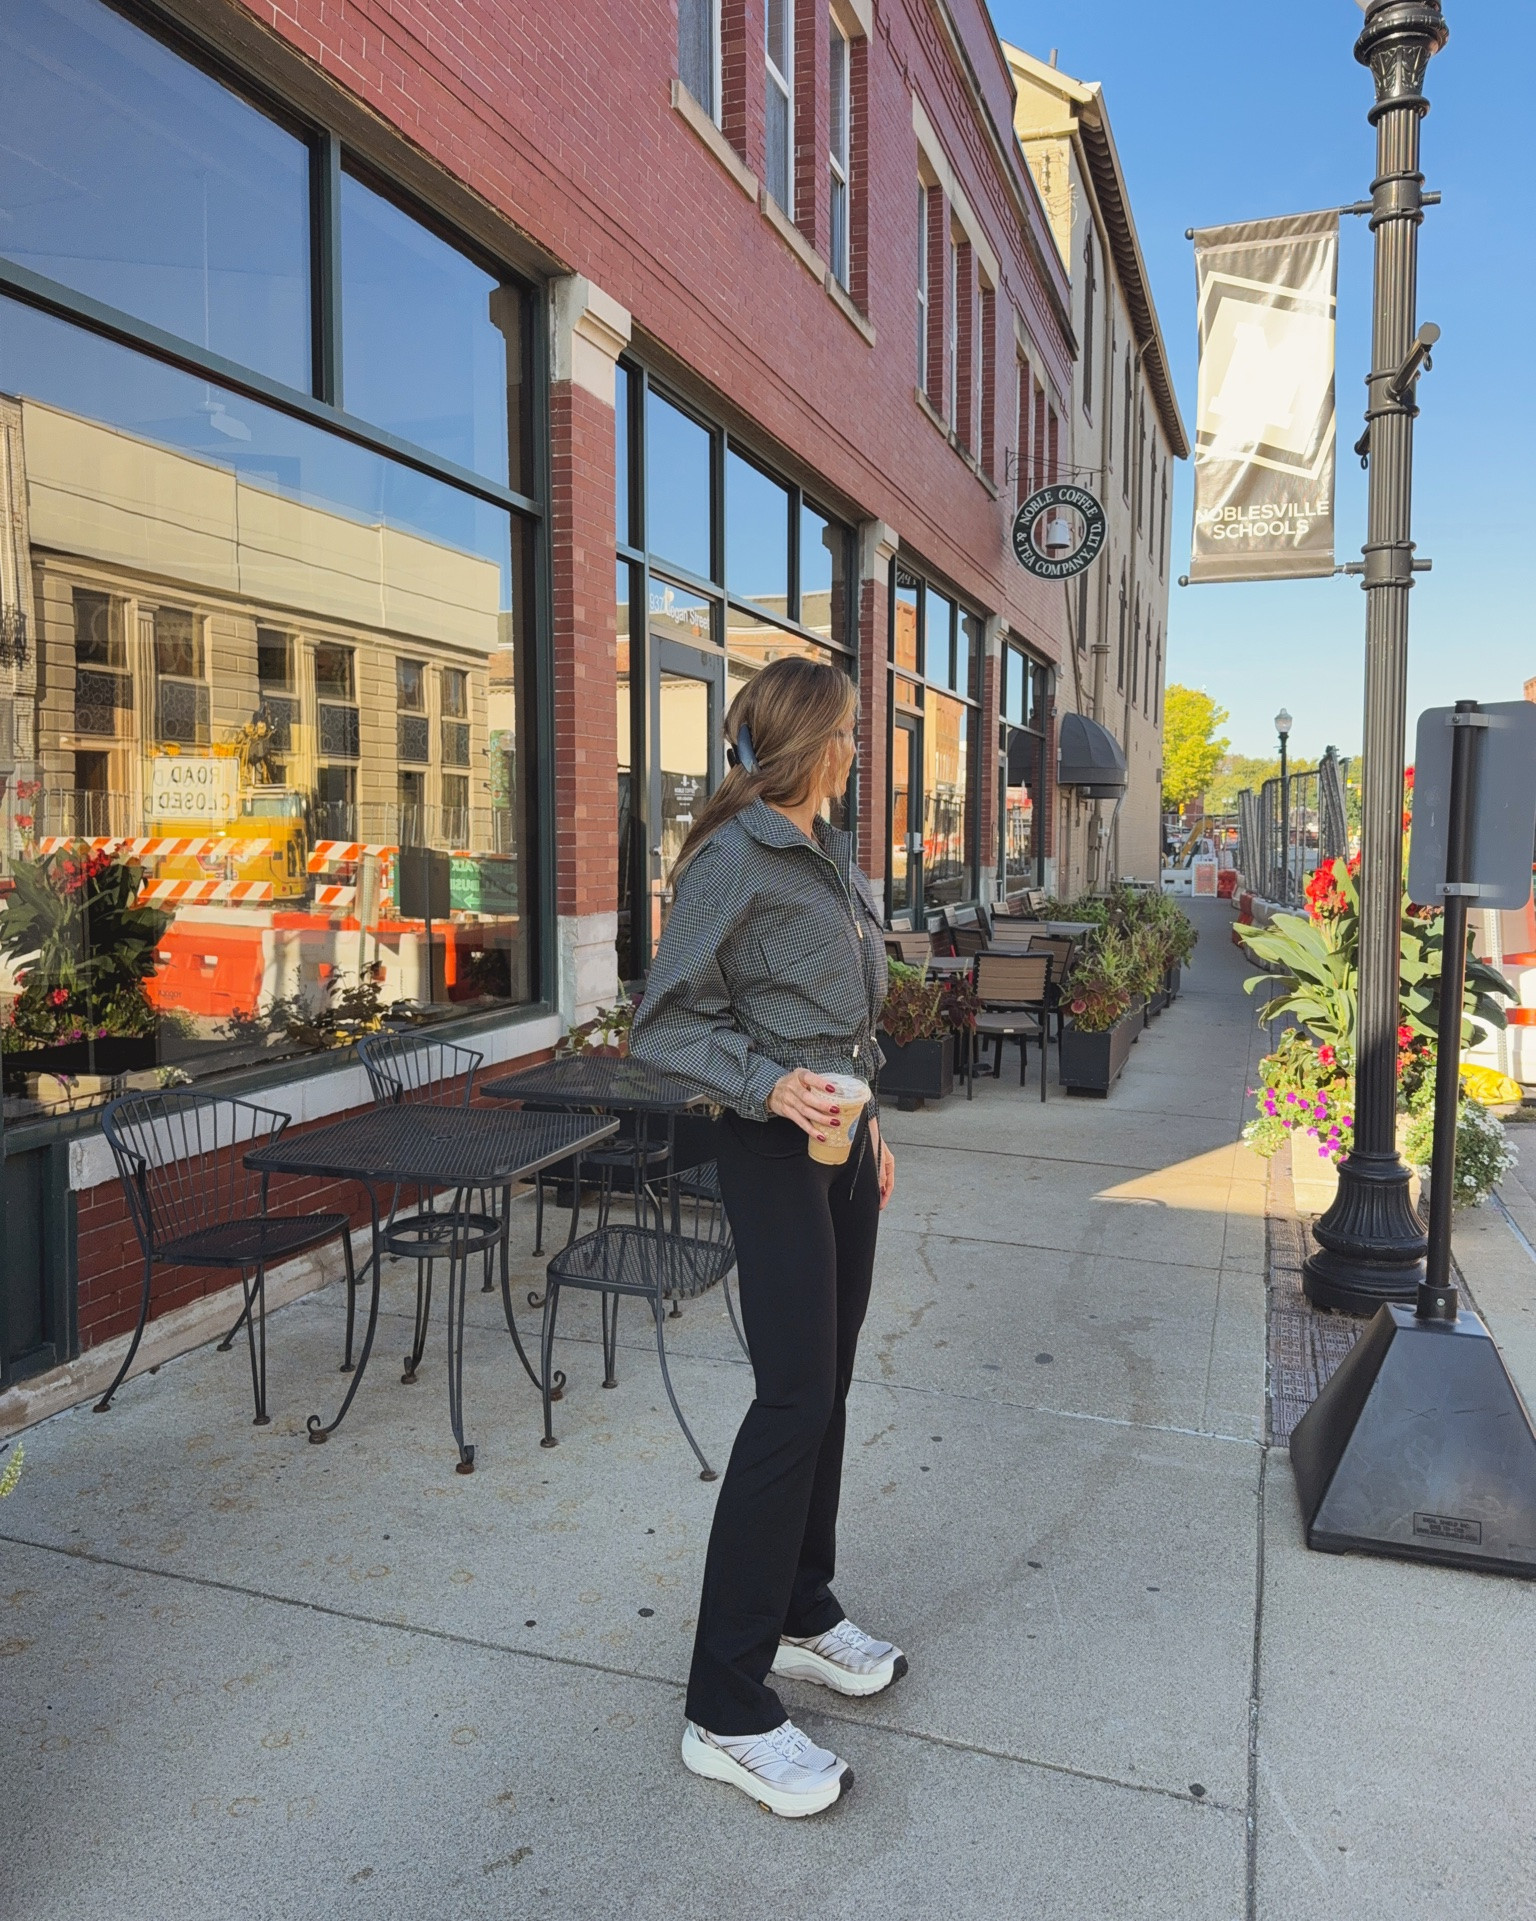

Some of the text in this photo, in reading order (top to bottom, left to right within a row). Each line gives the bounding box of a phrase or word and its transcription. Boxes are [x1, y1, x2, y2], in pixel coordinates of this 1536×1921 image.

[1019, 488, 1099, 525] NOBLE COFFEE
[1196, 500, 1330, 523] NOBLESVILLE
[1213, 519, 1310, 540] SCHOOLS
[1016, 521, 1102, 576] & TEA COMPANY, LTD.
[650, 593, 664, 611] 937
